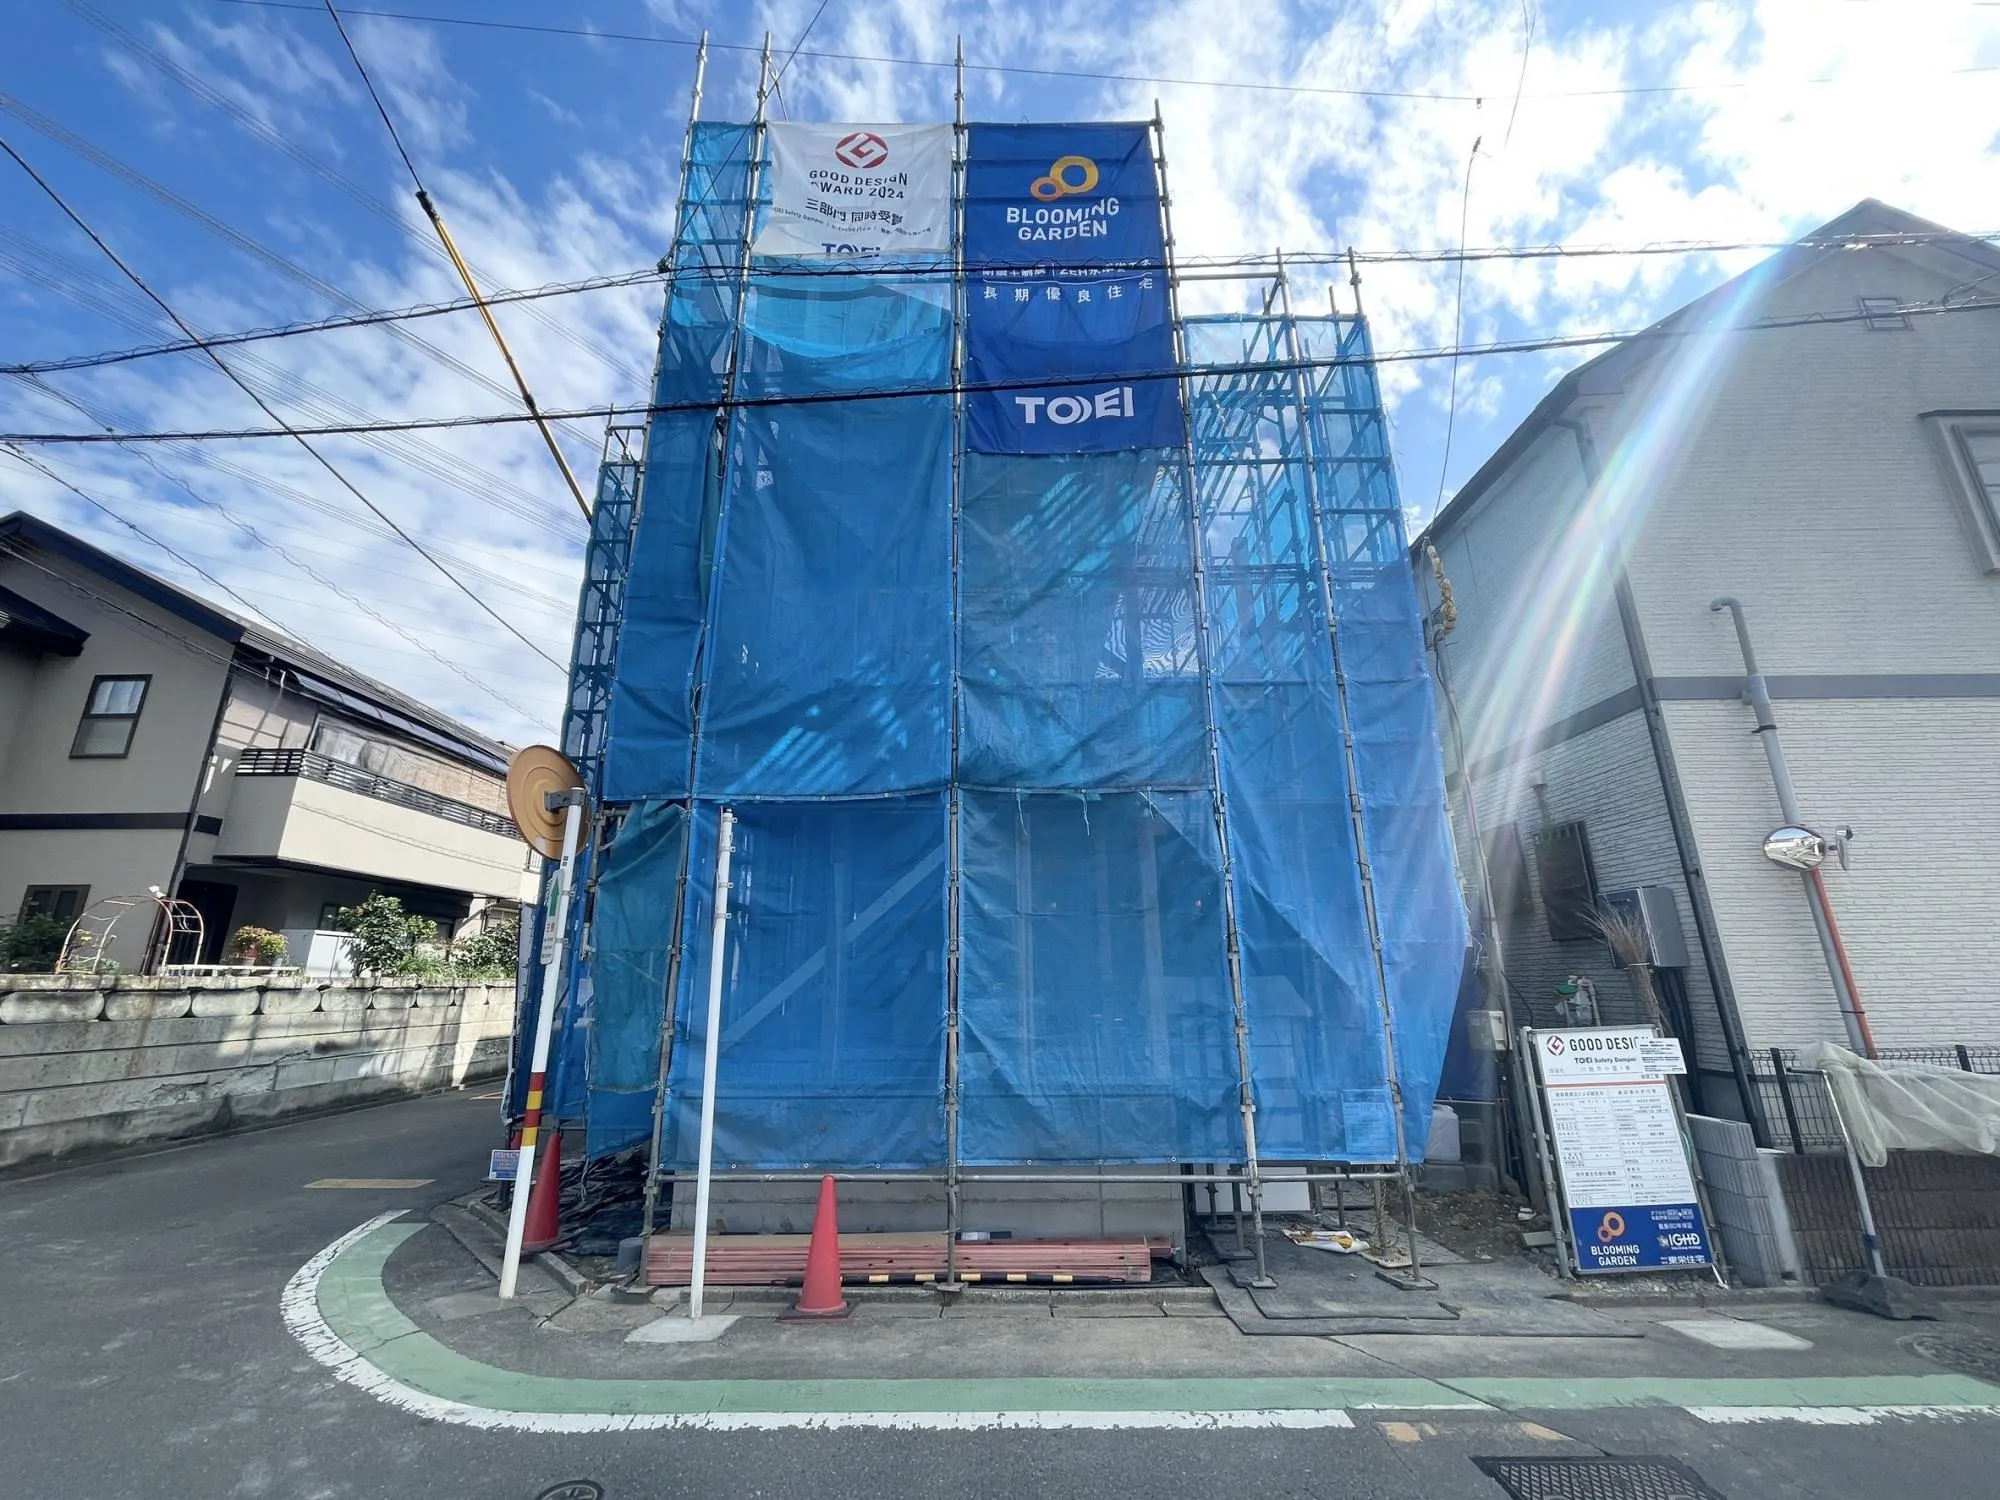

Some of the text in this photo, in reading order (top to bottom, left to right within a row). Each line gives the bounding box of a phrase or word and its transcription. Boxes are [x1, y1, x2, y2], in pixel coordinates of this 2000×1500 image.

[809, 170, 908, 187] GOOD DESIGN
[868, 186, 905, 199] 2024
[1006, 197, 1120, 224] BLOOMING
[1018, 220, 1108, 241] GARDEN
[984, 277, 1153, 303] 長期優良住宅
[1015, 387, 1134, 424] TOEI
[1569, 1038, 1603, 1051] GOOD
[1606, 1036, 1646, 1050] DESI
[1591, 1245, 1640, 1256] BLOOMING
[1598, 1255, 1637, 1266] GARDEN
